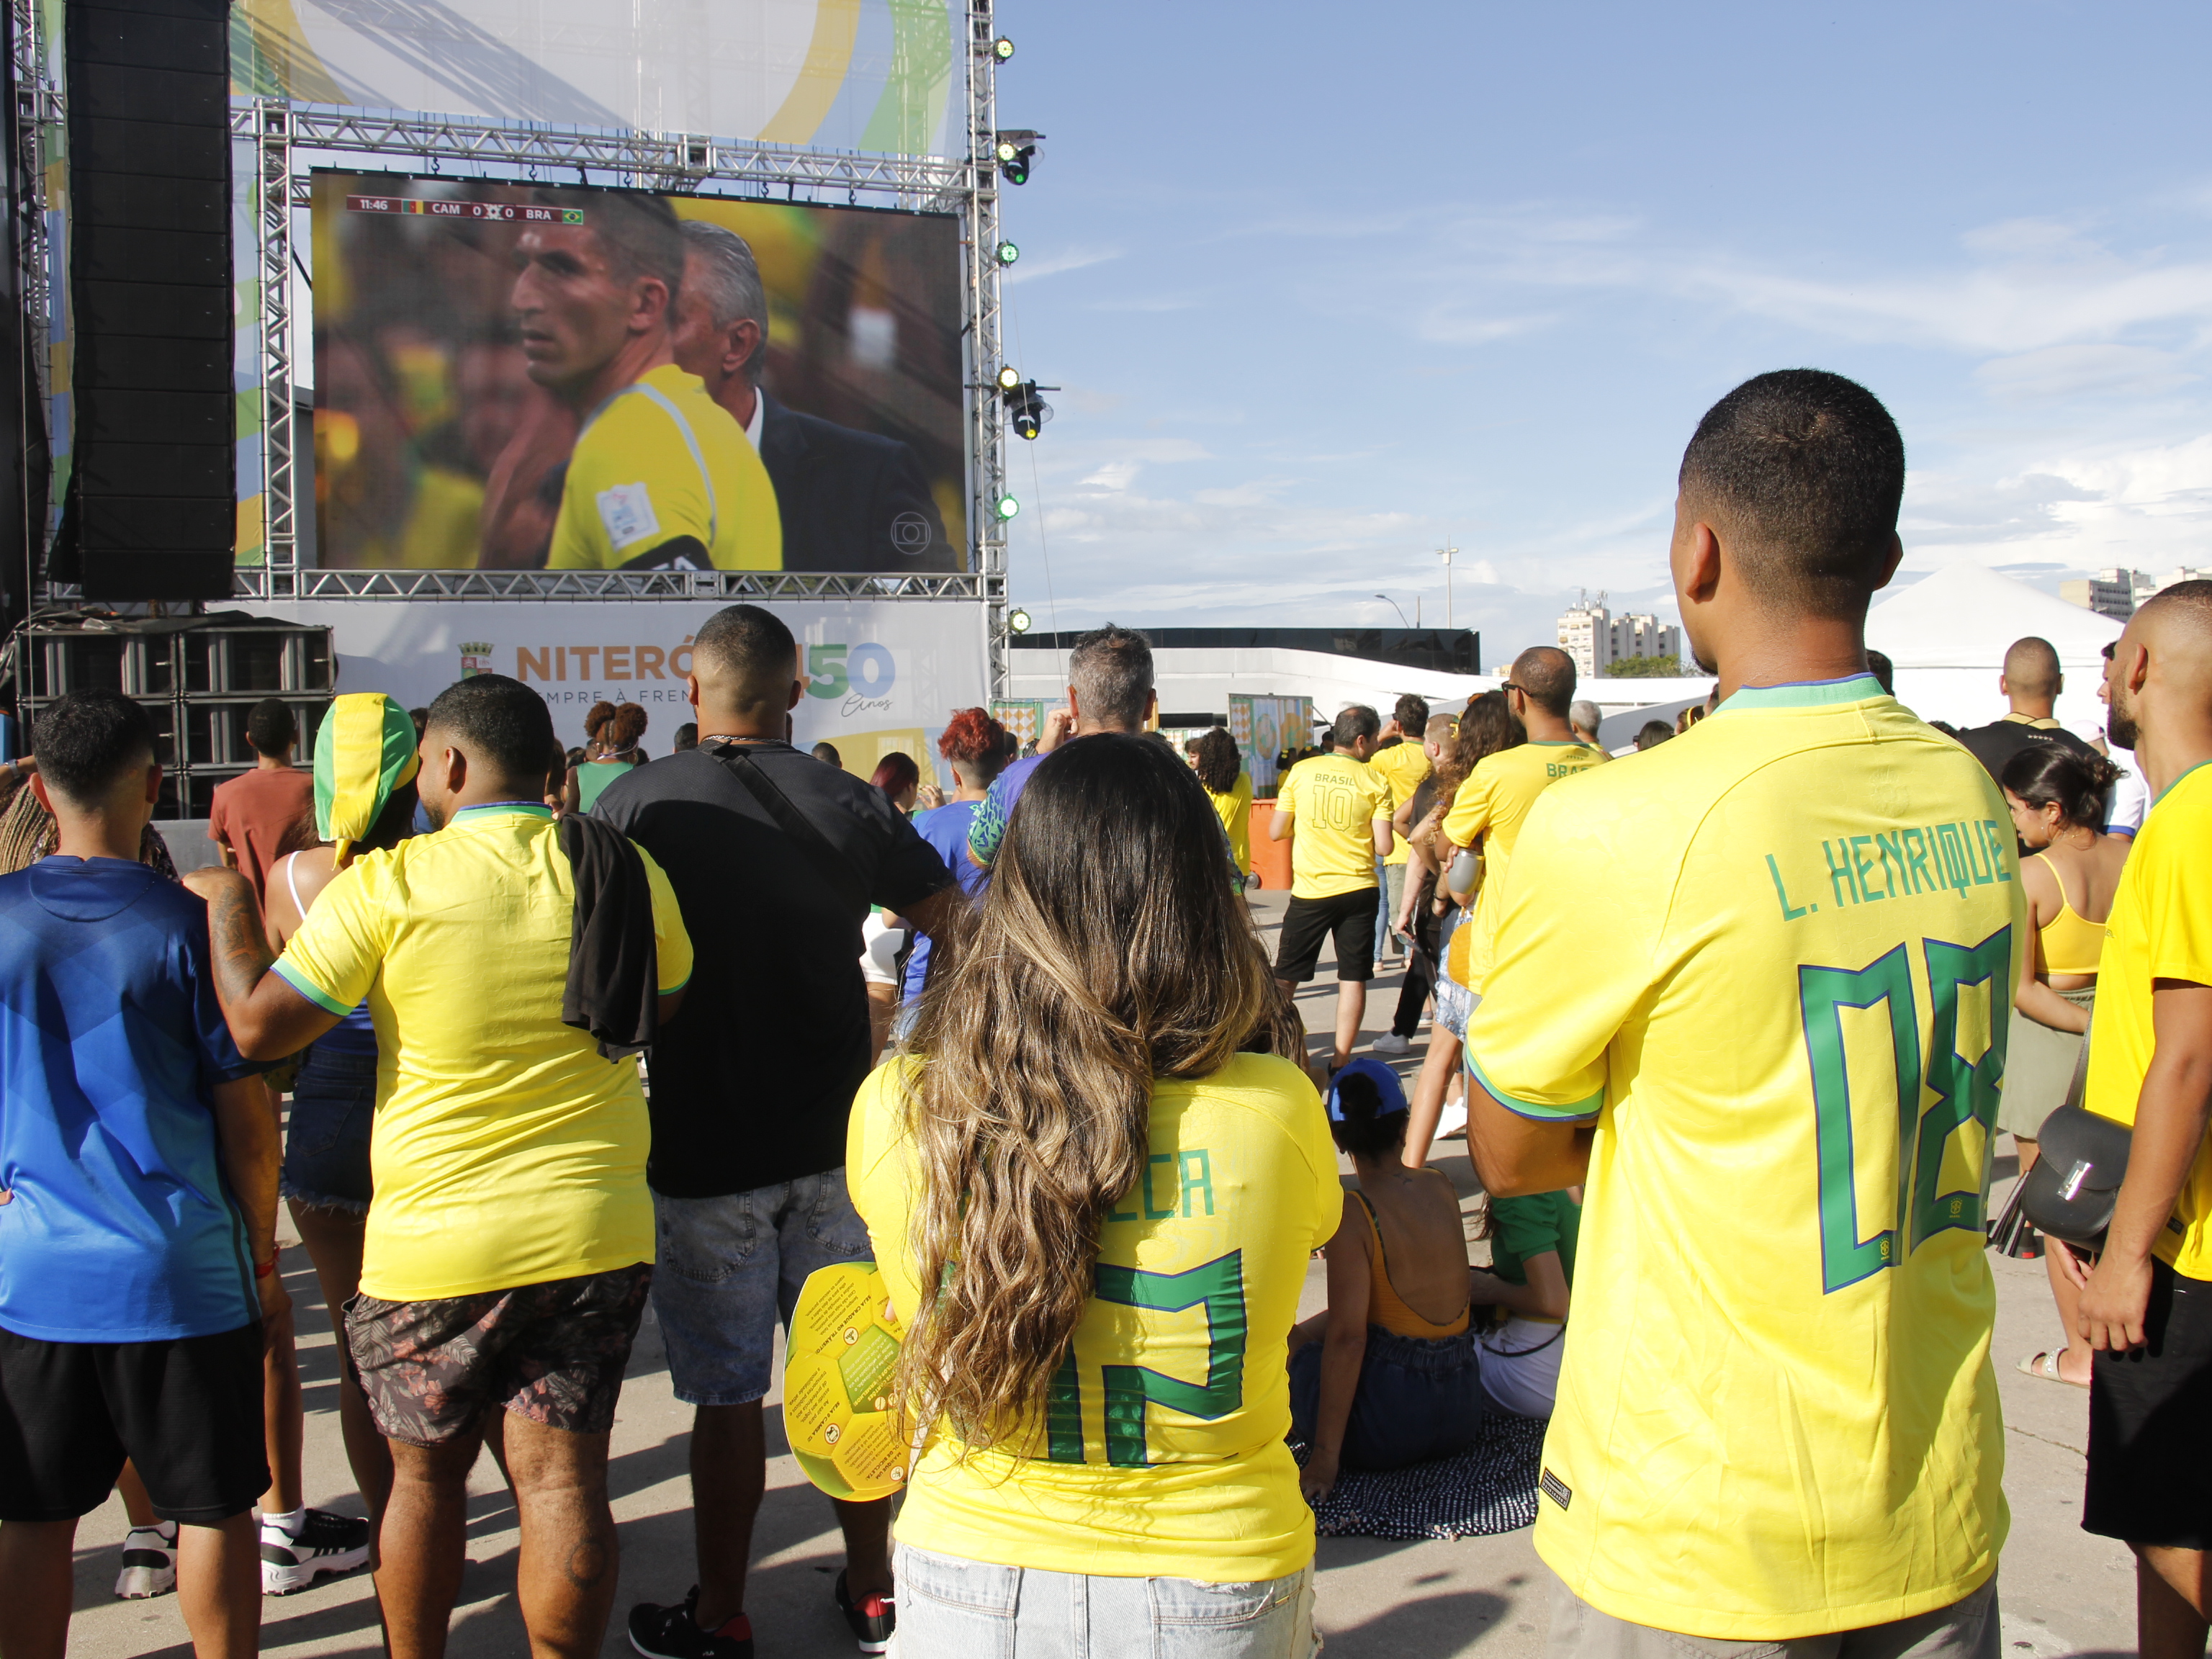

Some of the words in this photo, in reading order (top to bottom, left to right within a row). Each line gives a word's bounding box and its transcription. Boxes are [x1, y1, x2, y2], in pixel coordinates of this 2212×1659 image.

[359, 199, 388, 210] 11:46
[432, 203, 460, 215] CAM
[472, 202, 482, 216] 0
[505, 204, 514, 218] 0
[526, 209, 552, 220] BRA
[516, 634, 695, 681] NITERÓ
[539, 691, 603, 704] MPRE
[639, 690, 689, 702] FREN
[1546, 763, 1589, 778] BRA
[1315, 773, 1355, 786] BRASIL
[1312, 785, 1353, 832] 10
[1766, 854, 1818, 921] L.
[1822, 820, 2013, 899] HENRIQUE
[832, 1274, 845, 1287] espere
[837, 1282, 847, 1290] olhe
[830, 1288, 839, 1298] para
[842, 1282, 855, 1295] sinalize
[847, 1289, 856, 1298] Caso
[817, 1289, 832, 1303] veículos
[826, 1295, 841, 1311] intenção
[845, 1295, 858, 1309] Sempre
[860, 1295, 872, 1307] SEJA
[820, 1300, 829, 1309] dois
[833, 1303, 842, 1312] haja
[811, 1307, 822, 1317] lados
[827, 1310, 836, 1319] uma
[830, 1307, 847, 1323] atravesse
[842, 1305, 862, 1325] CRAQUE
[835, 1322, 845, 1331] NO
[813, 1330, 839, 1356] TRÂNSITO!
[869, 1334, 883, 1348] celular
[880, 1342, 892, 1354] limite
[796, 1370, 819, 1395] mobilidade
[805, 1370, 827, 1395] transportes
[787, 1393, 799, 1407] ativa.
[800, 1385, 823, 1411] preferência
[816, 1388, 830, 1403] assistir
[791, 1393, 808, 1413] públicos
[822, 1399, 830, 1408] Ao
[828, 1401, 841, 1414] SEJA
[794, 1409, 804, 1419] aos
[816, 1406, 824, 1415] sair
[807, 1413, 818, 1424] para
[811, 1416, 829, 1436] CAMISA
[859, 1424, 874, 1439] quando
[866, 1425, 881, 1441] calçada
[871, 1430, 884, 1444] pedale
[842, 1445, 861, 1465] permitido
[886, 1449, 894, 1458] DE
[864, 1456, 888, 1481] BICICLETA!
[881, 1451, 902, 1472] MARQUE
[874, 1470, 884, 1480] UM
